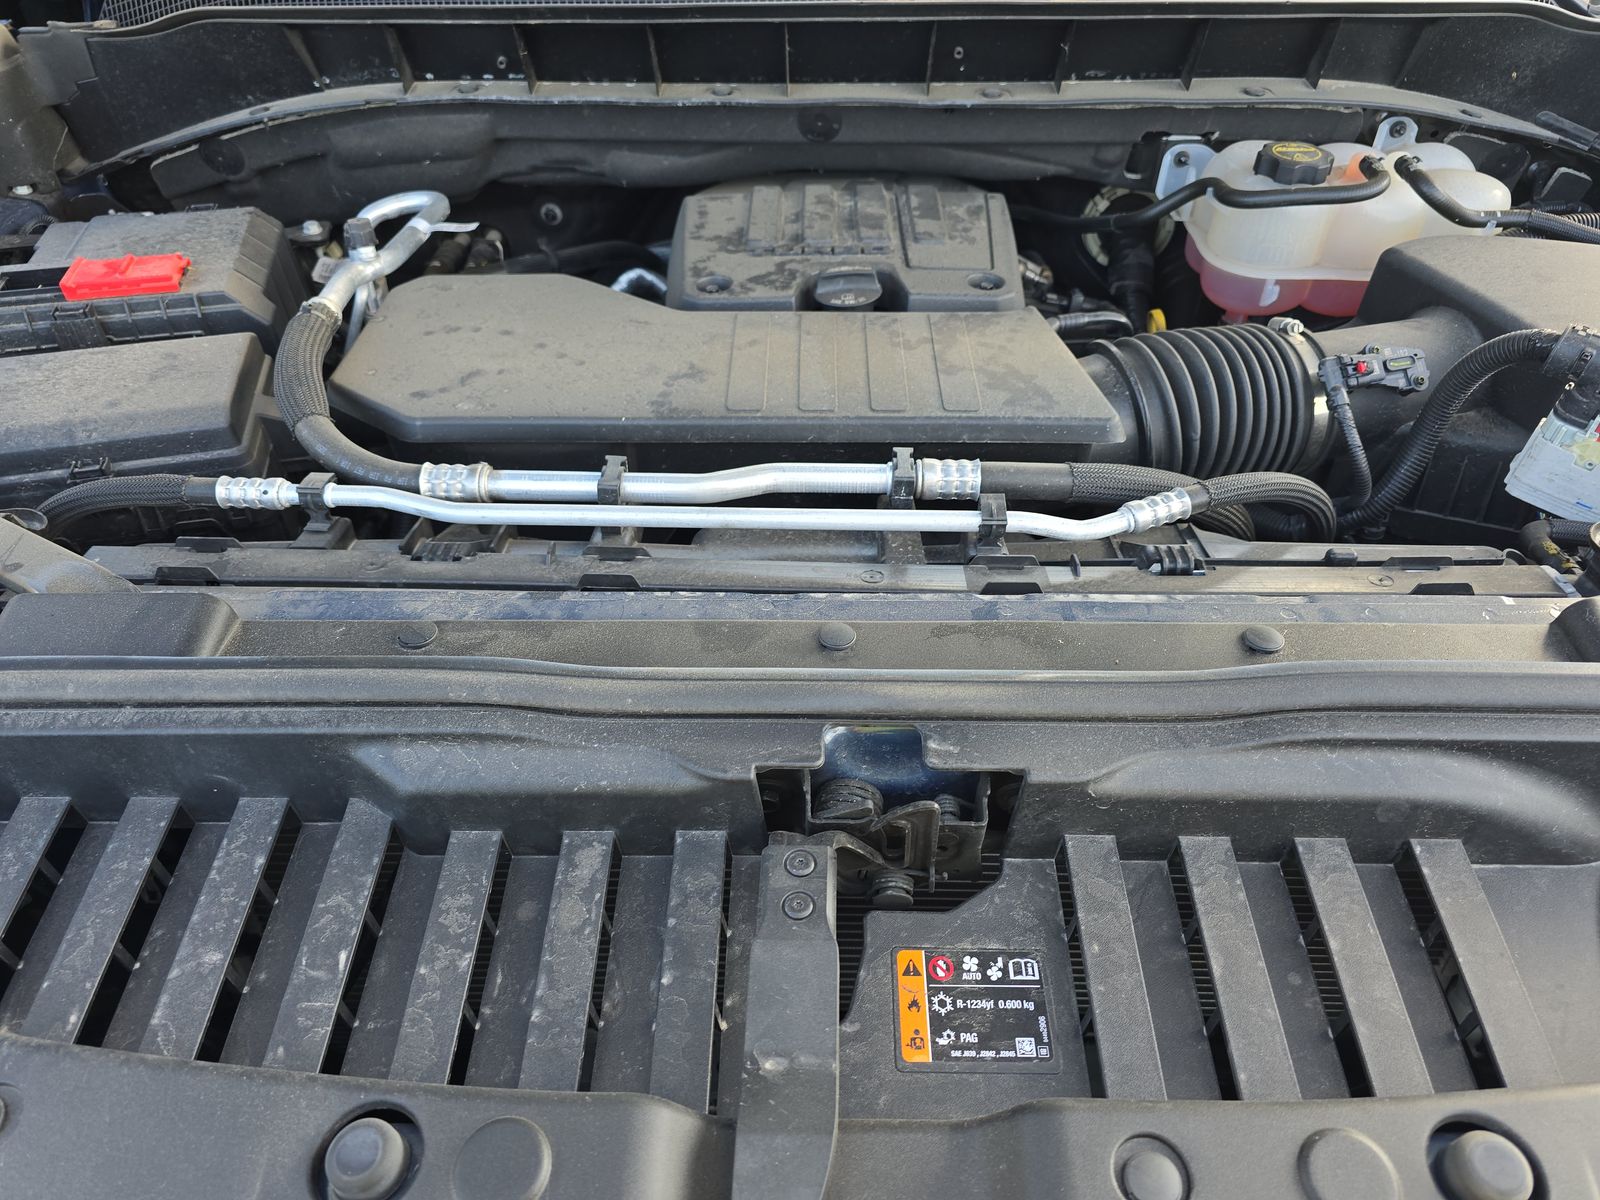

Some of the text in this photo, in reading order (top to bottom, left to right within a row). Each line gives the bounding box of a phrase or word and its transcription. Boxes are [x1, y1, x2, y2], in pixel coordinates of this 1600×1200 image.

[962, 972, 982, 980] AUTO
[956, 1000, 1035, 1011] R-1234yf 0.600 kg
[960, 1032, 979, 1043] PAG
